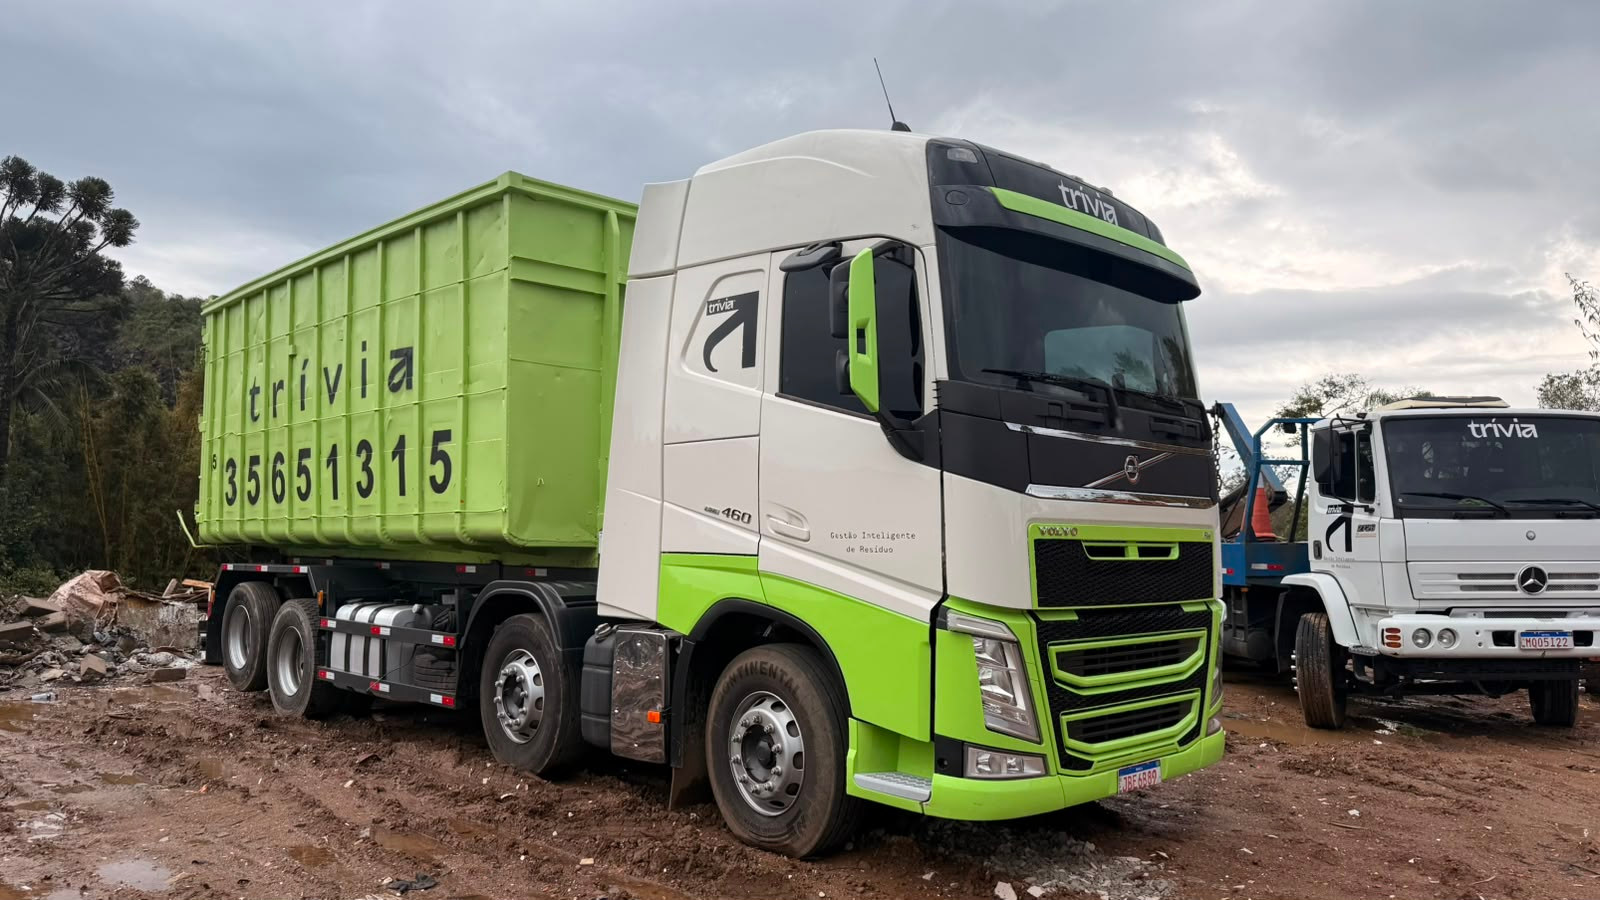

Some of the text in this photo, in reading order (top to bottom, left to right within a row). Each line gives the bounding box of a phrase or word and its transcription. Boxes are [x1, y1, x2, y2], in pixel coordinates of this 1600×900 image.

[1467, 417, 1539, 439] trívia
[225, 429, 452, 506] 35651315
[721, 507, 752, 525] 460
[830, 531, 917, 541] Gestão Inteligente
[1038, 525, 1078, 537] VOLVO
[846, 545, 856, 554] de
